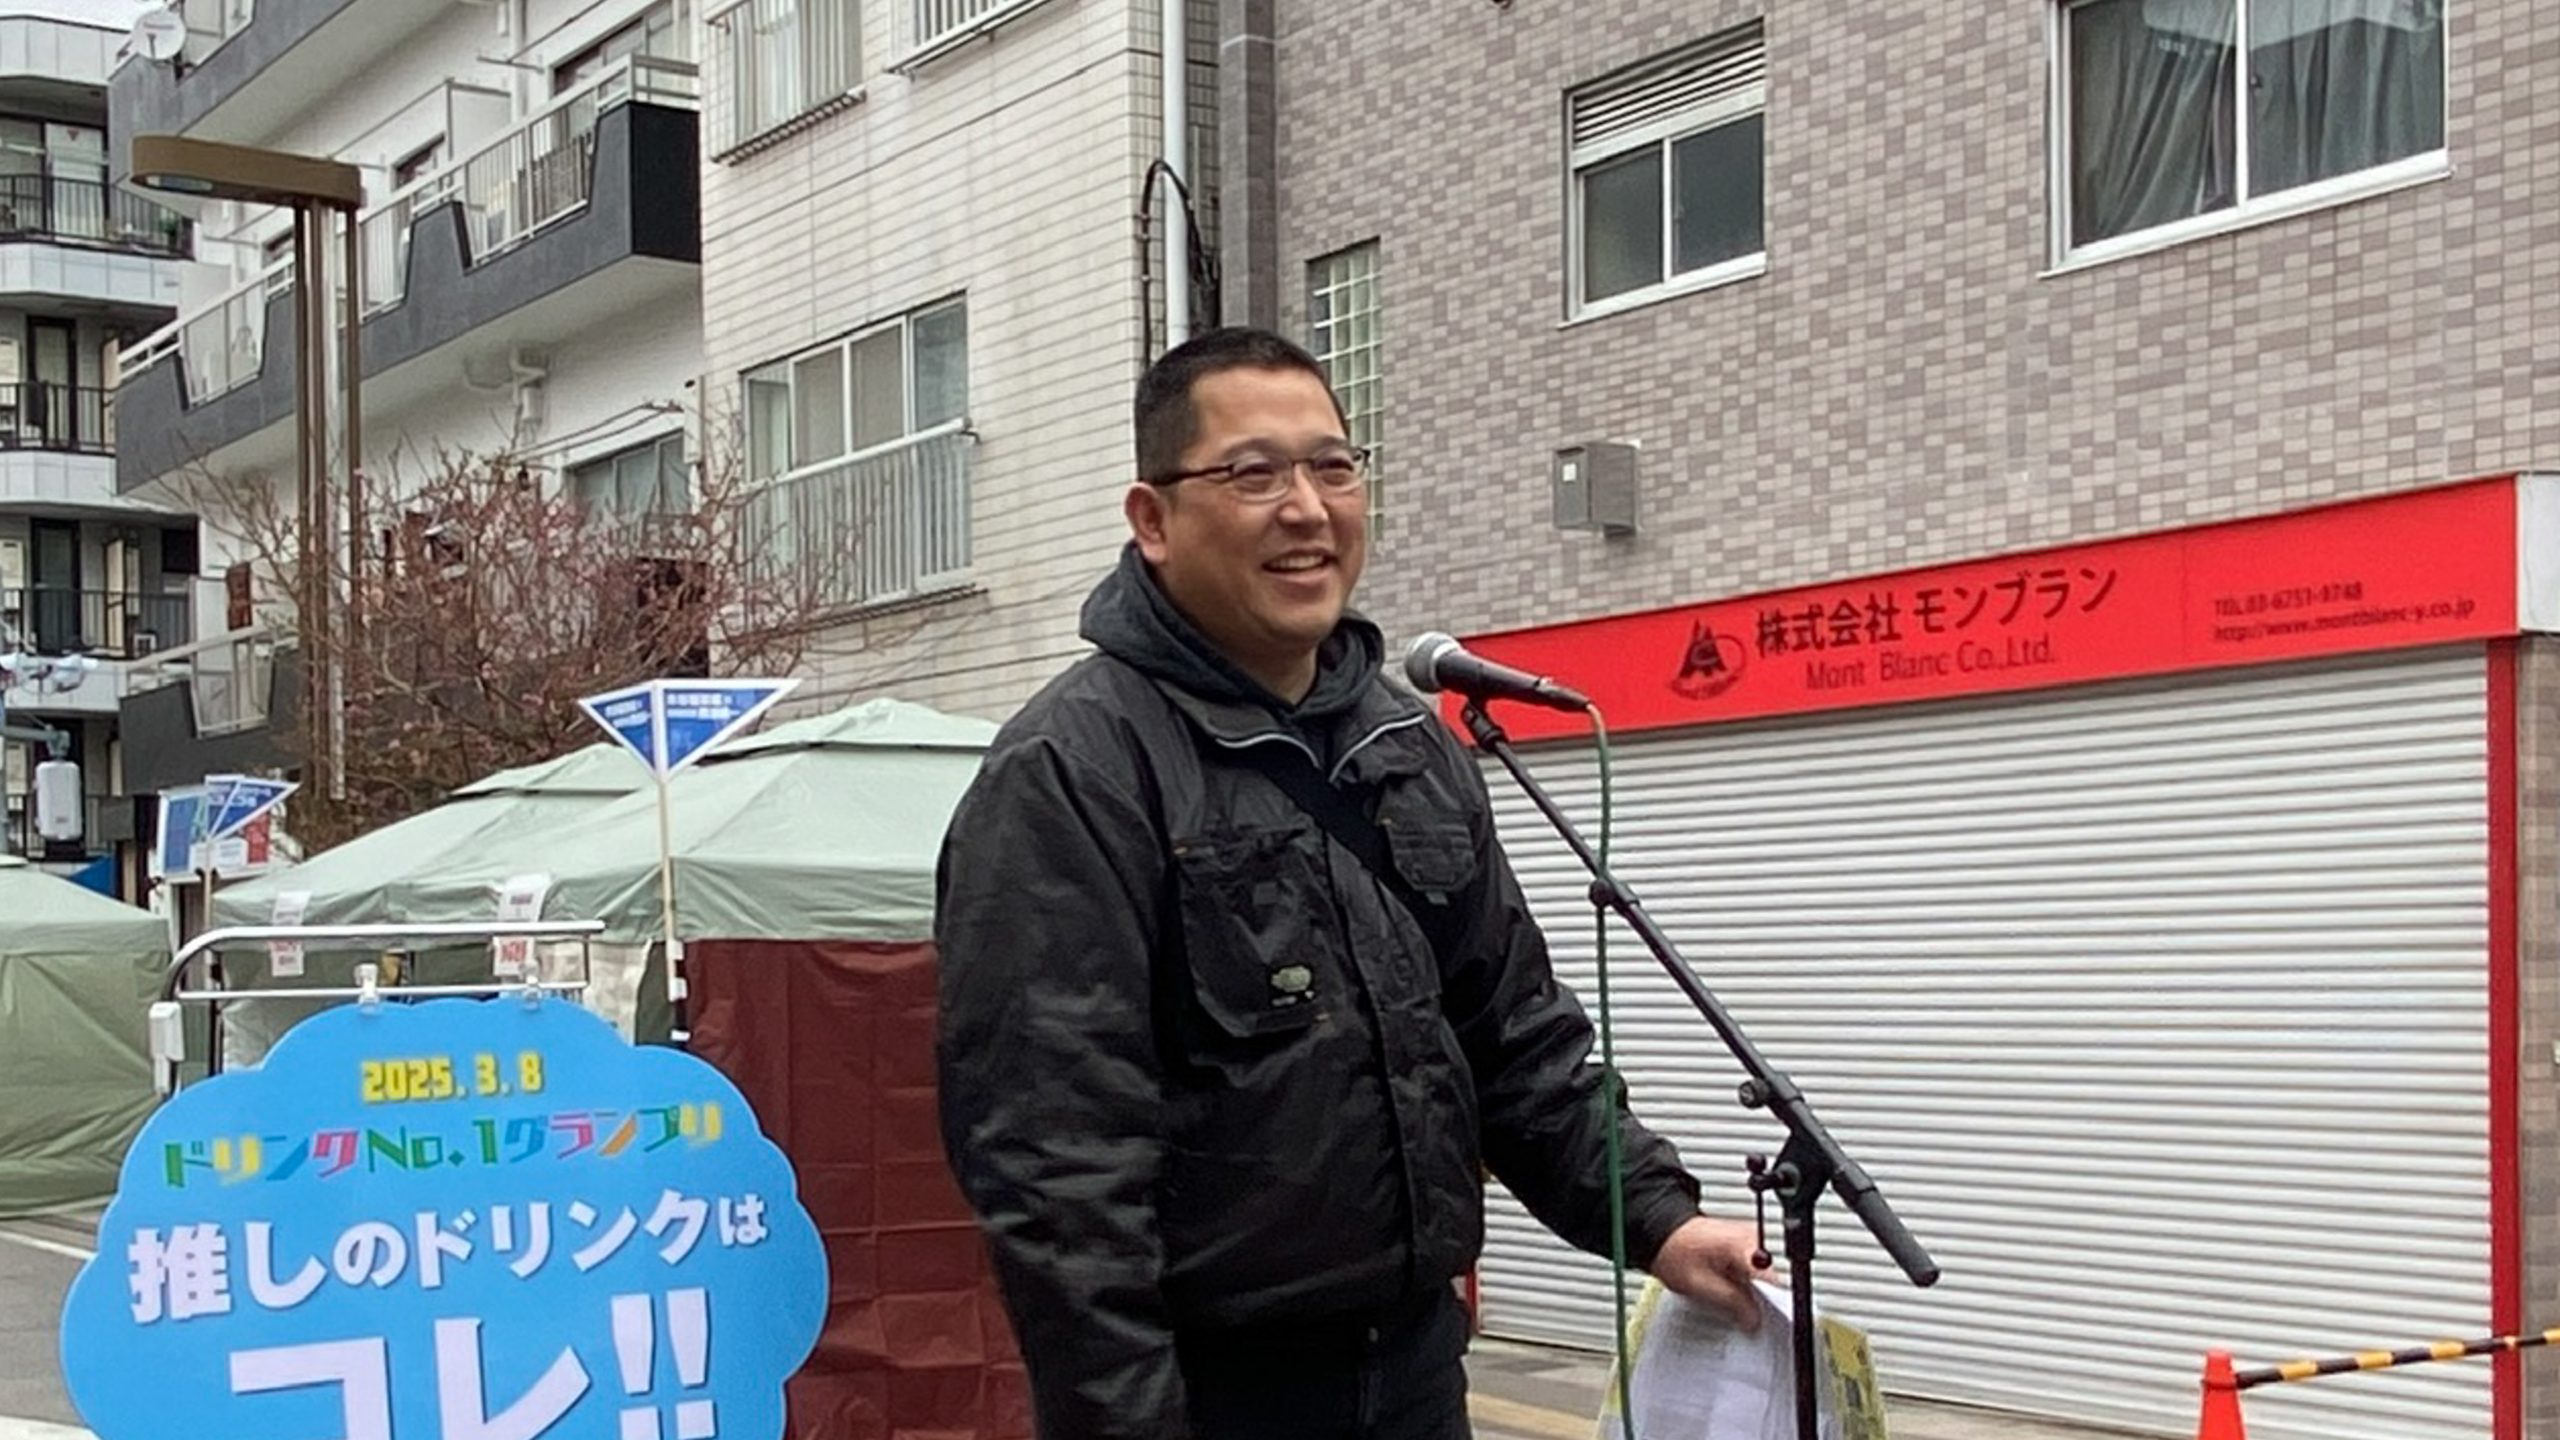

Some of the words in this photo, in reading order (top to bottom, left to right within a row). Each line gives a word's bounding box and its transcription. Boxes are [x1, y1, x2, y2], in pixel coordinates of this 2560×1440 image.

[1757, 593, 1901, 658] 株式会社
[1914, 569, 2117, 634] モンブラン
[1806, 661, 1866, 691] Mont
[1880, 648, 1949, 683] Blanc
[164, 1102, 723, 1187] ドリンクNo.1グランプリ
[128, 1189, 768, 1325] 推しのドリンクは
